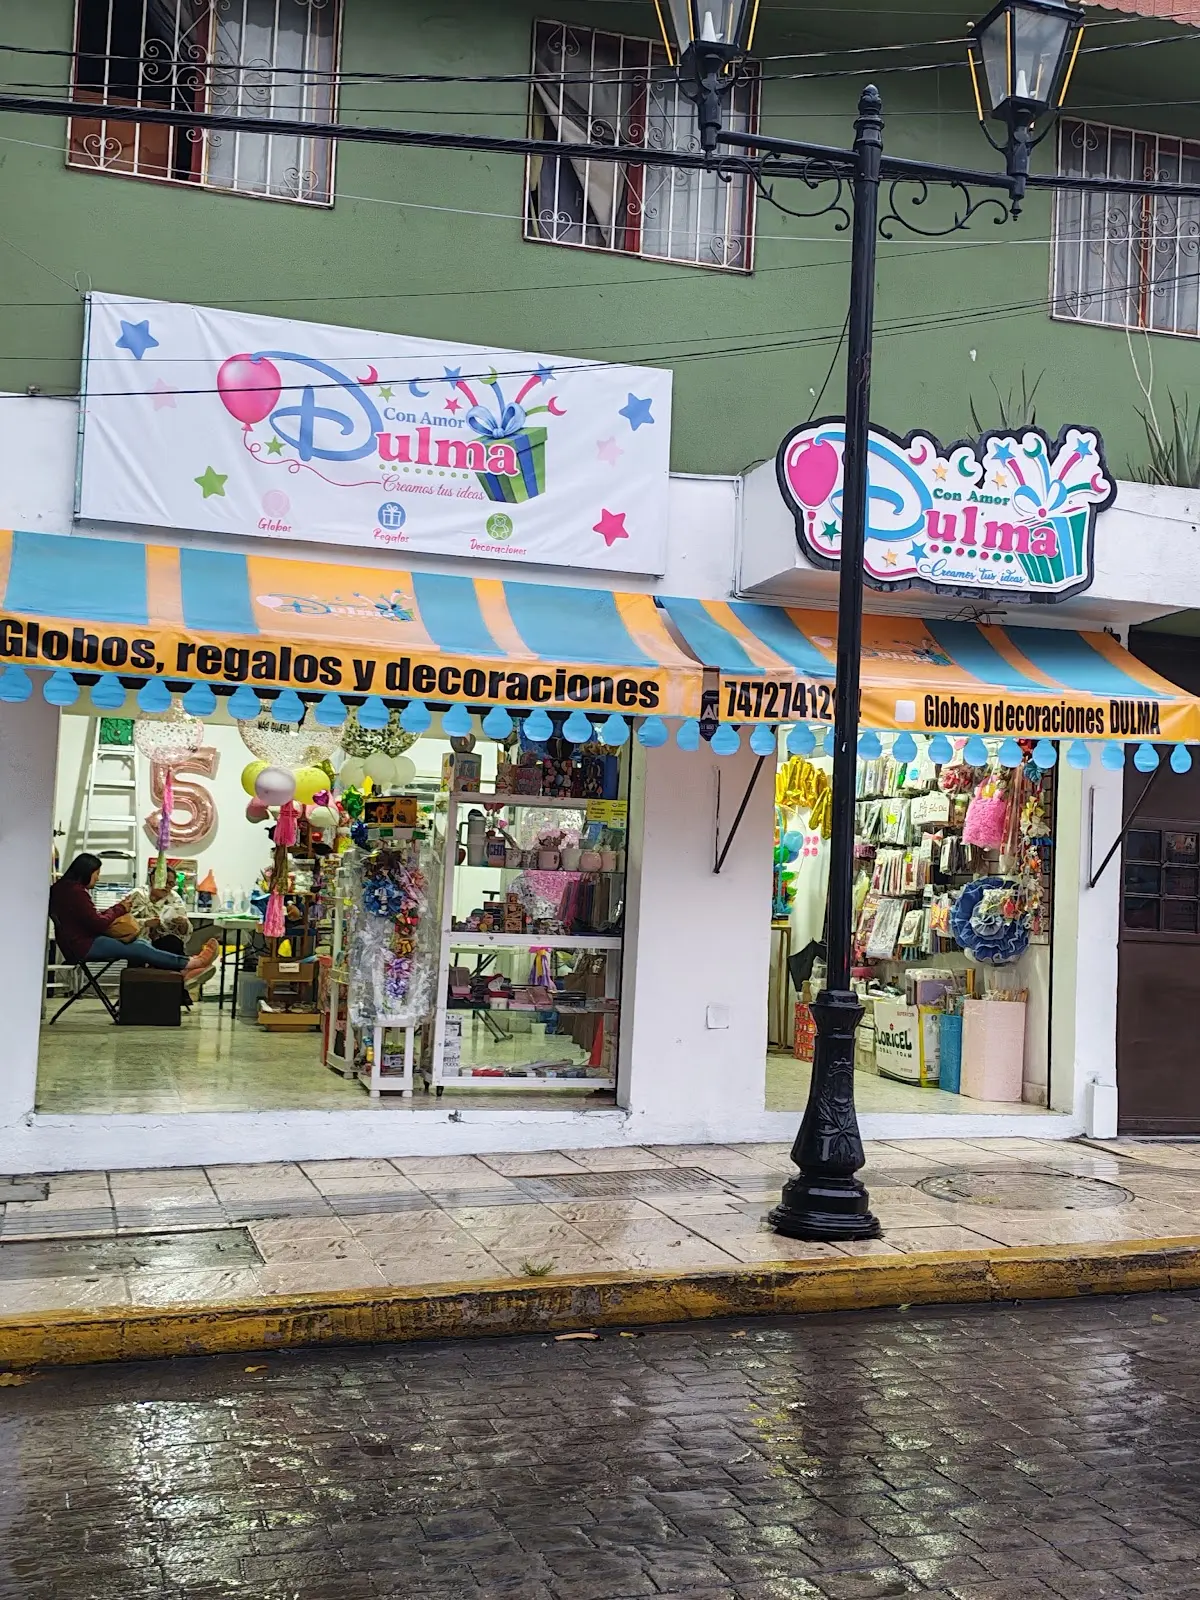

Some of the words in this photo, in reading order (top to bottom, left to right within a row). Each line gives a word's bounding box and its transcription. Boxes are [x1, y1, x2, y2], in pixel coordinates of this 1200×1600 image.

[383, 407, 416, 422] Con
[420, 411, 465, 428] Amor
[381, 474, 434, 495] Creamos
[437, 486, 454, 497] tus
[456, 487, 485, 500] ideas
[933, 488, 962, 501] Con
[967, 490, 1011, 505] Amor
[258, 517, 292, 533] Globos
[373, 528, 410, 544] Regalos
[470, 539, 527, 555] Decoraciones
[920, 559, 976, 579] Creamos
[979, 567, 996, 580] tus
[1000, 570, 1025, 583] ideas
[0, 619, 164, 674] Globos,
[177, 641, 342, 686] regalos
[352, 659, 376, 691] y
[386, 657, 660, 709] decoraciones
[725, 681, 862, 722] 74727412
[924, 694, 980, 730] Globos
[983, 703, 992, 733] y
[994, 700, 1105, 735] decoraciones
[1110, 700, 1161, 735] DULMA
[876, 1031, 912, 1050] LORICEL
